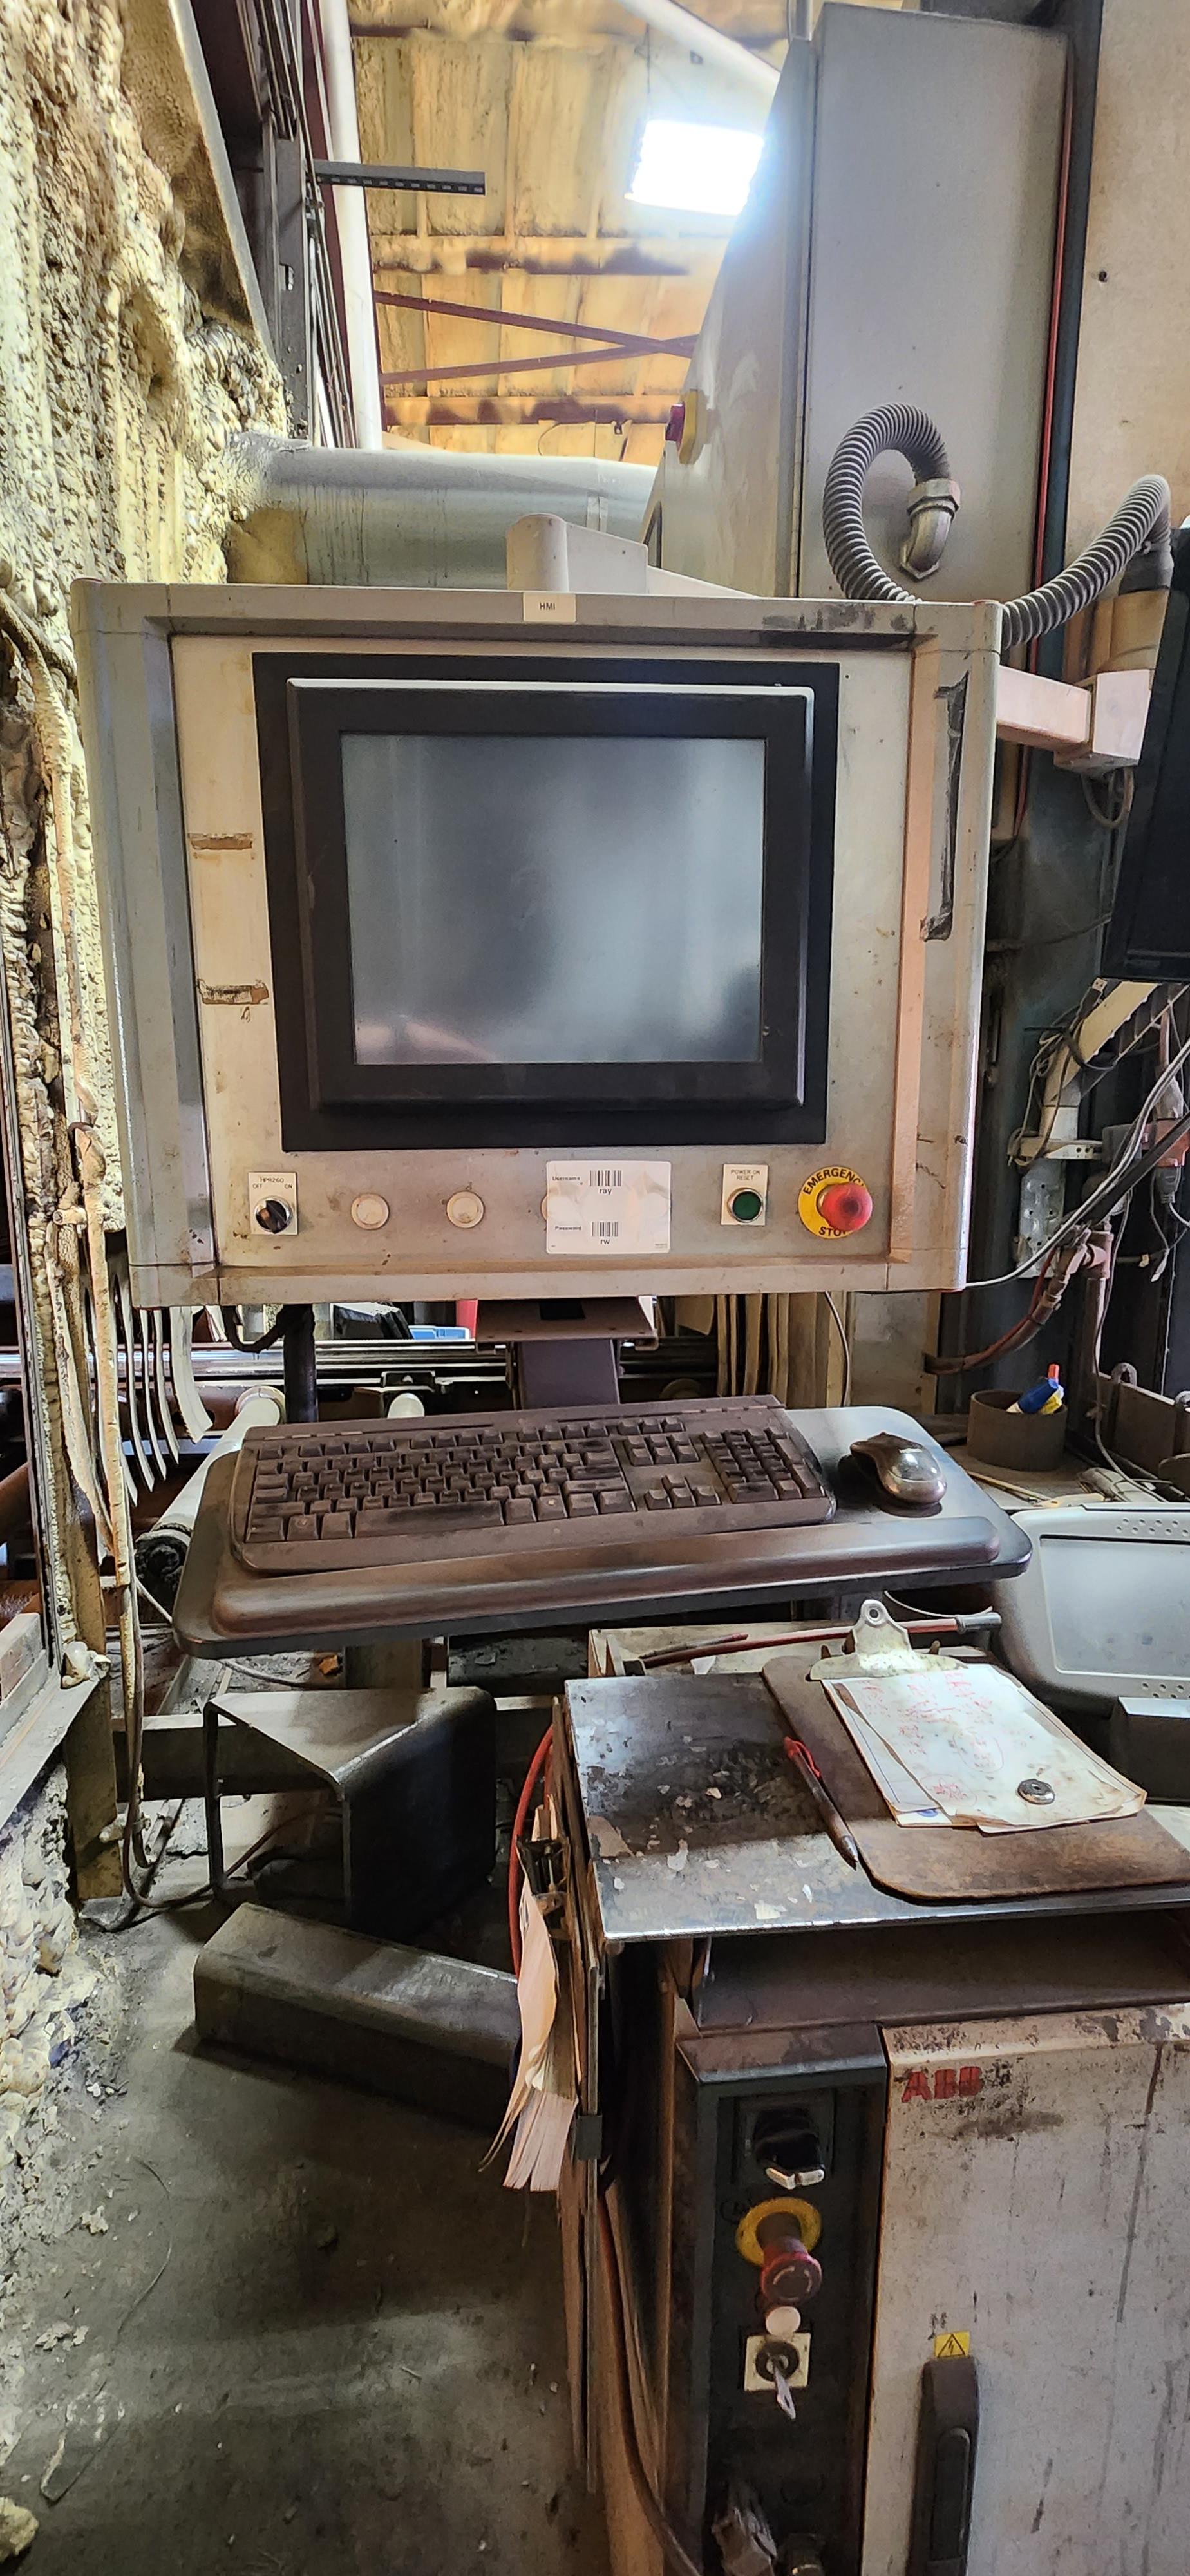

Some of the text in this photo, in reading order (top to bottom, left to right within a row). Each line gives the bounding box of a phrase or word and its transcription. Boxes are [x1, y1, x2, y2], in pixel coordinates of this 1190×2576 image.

[803, 1168, 864, 1195] EMERGENC
[818, 1226, 846, 1236] STO
[901, 2066, 985, 2103] ABB
